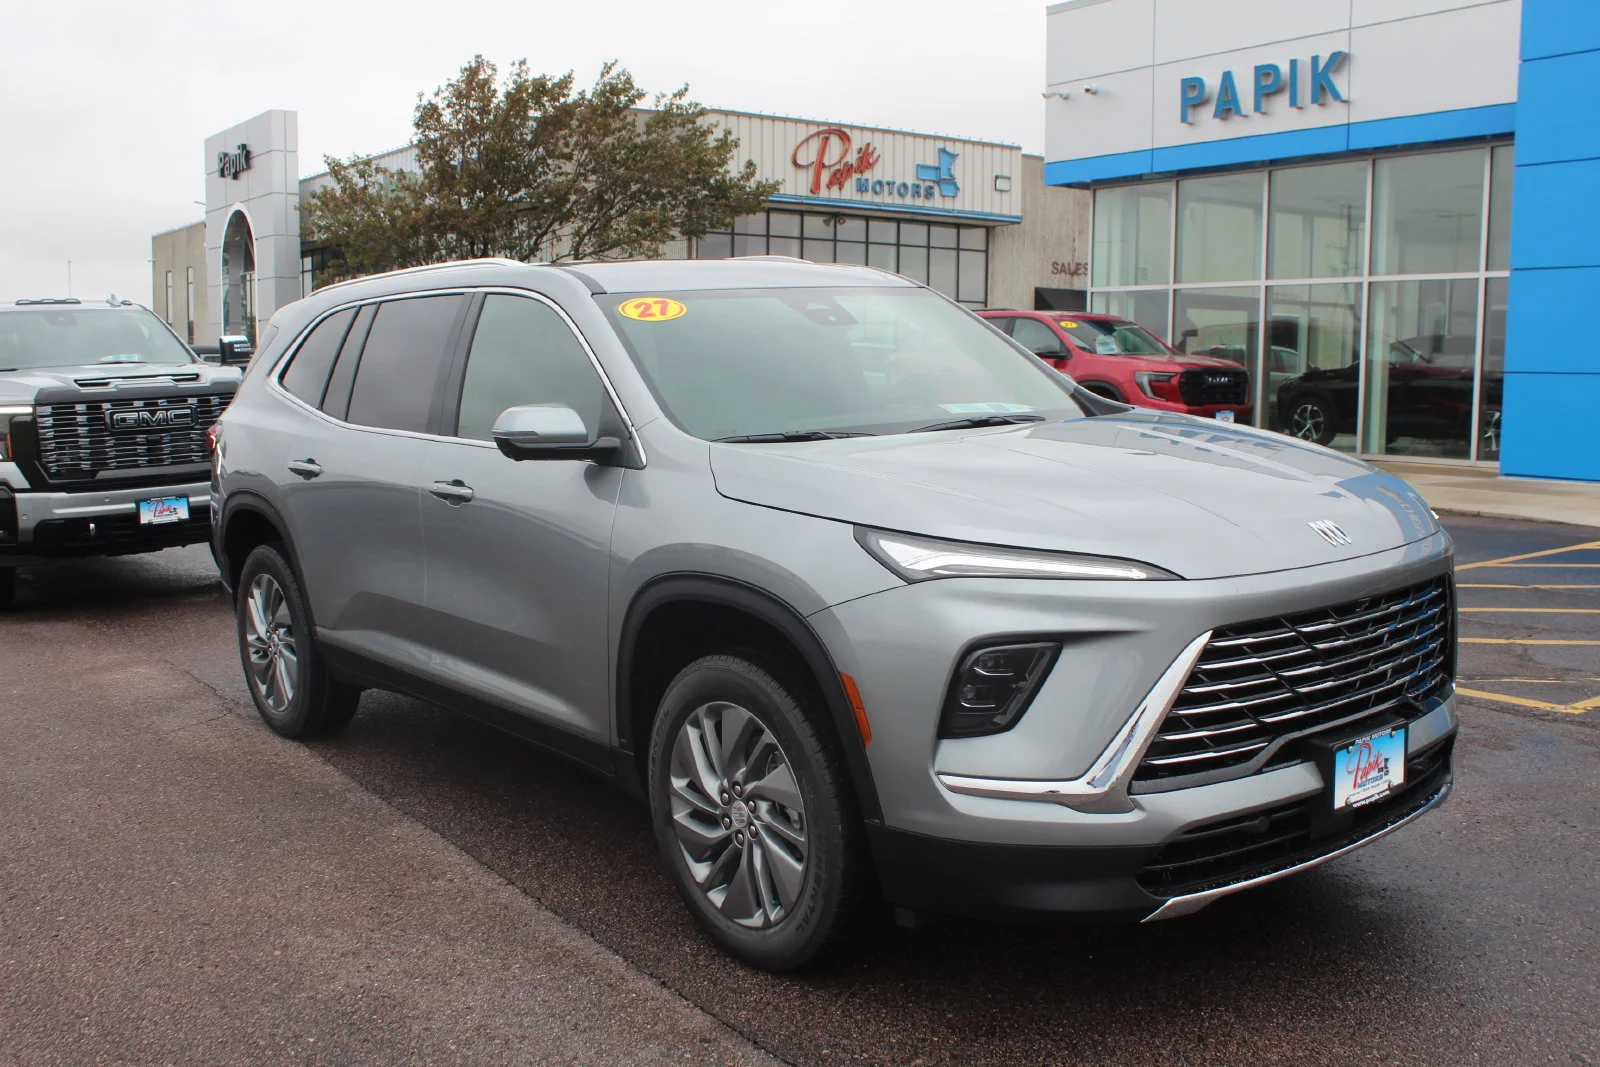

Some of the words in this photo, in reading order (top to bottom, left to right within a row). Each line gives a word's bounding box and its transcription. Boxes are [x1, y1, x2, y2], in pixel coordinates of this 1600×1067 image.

[1180, 51, 1348, 124] PAPIK
[218, 143, 251, 180] Papik
[791, 128, 881, 194] Papik
[855, 177, 935, 199] MOTORS
[1051, 261, 1088, 276] SALES
[633, 299, 670, 318] 27
[113, 409, 191, 428] GMC
[1346, 742, 1383, 789] Papik
